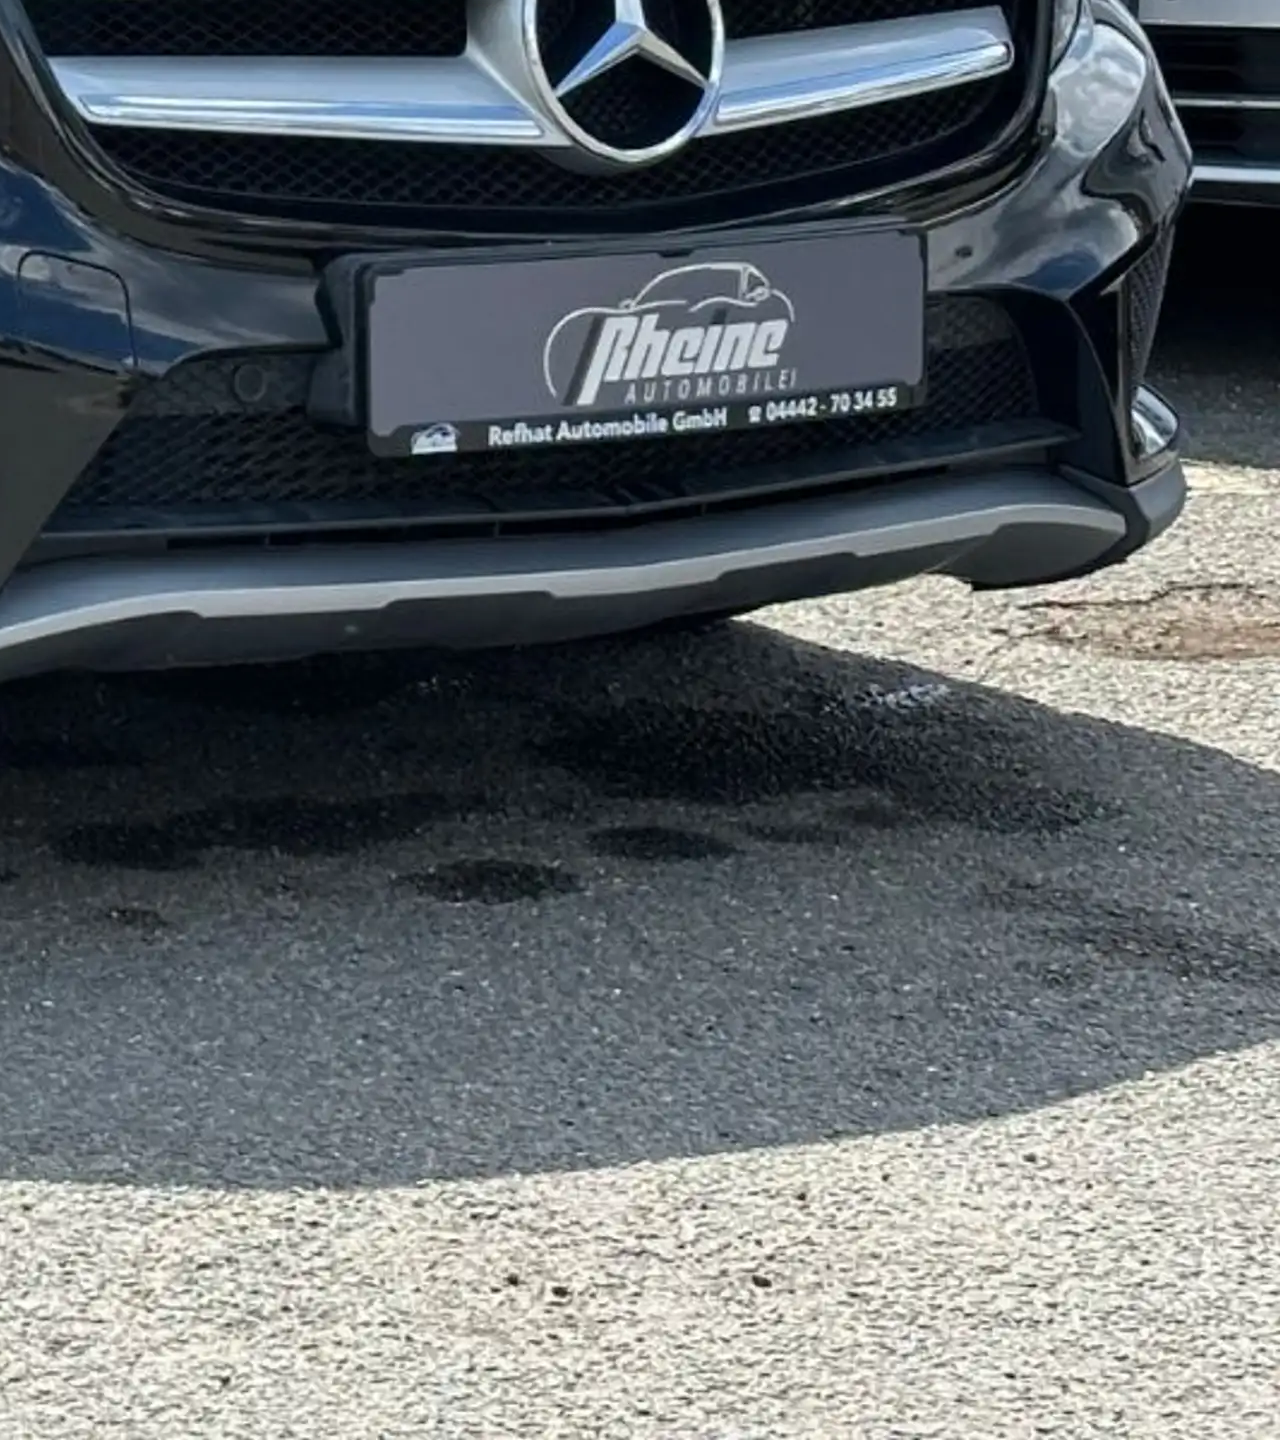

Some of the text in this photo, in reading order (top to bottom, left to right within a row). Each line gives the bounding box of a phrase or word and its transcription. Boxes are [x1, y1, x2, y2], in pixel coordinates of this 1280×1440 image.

[576, 312, 789, 405] Rheine
[556, 412, 668, 441] Automobile
[672, 407, 727, 431] GmbH
